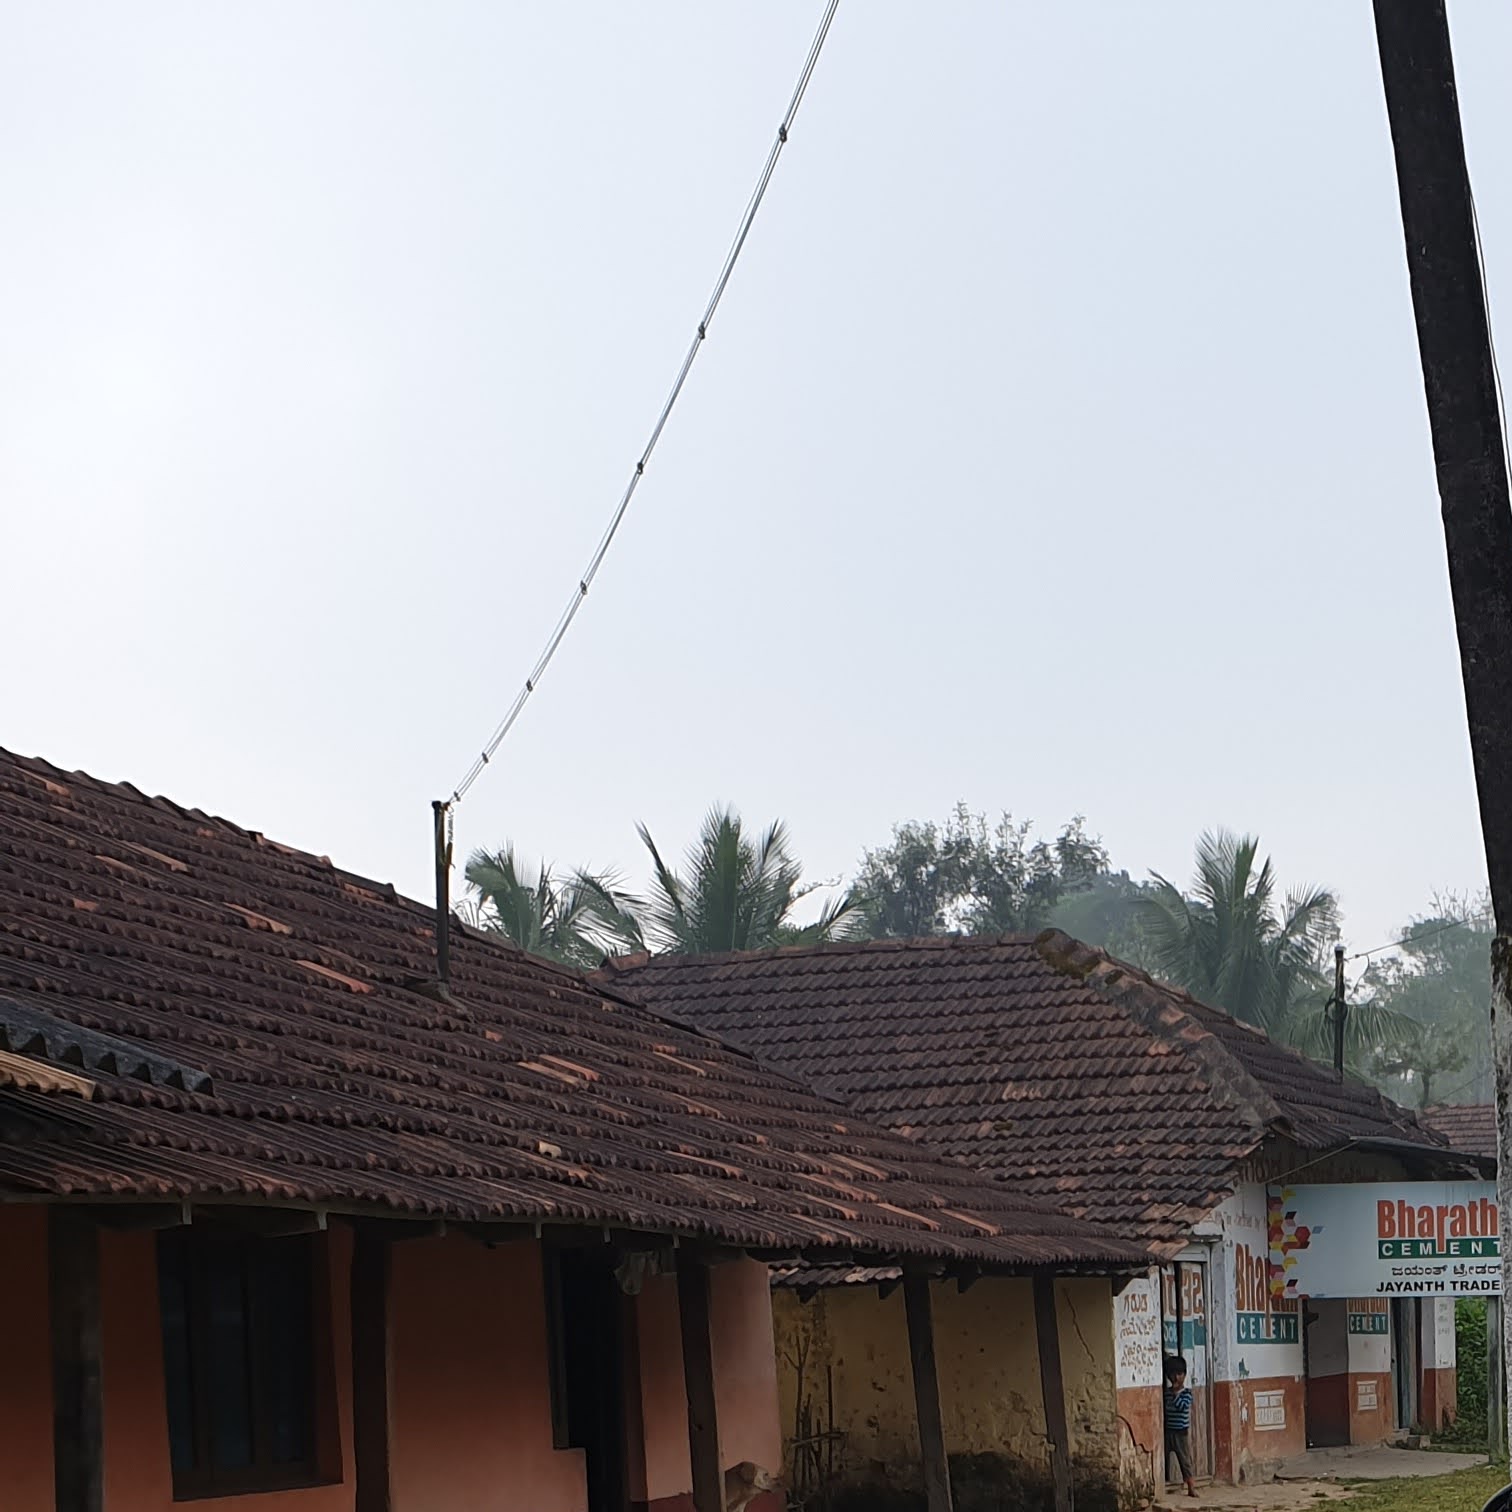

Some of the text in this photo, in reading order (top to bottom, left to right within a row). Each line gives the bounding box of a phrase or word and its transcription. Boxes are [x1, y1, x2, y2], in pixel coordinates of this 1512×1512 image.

[1377, 1197, 1499, 1254] Bharath
[1381, 1241, 1501, 1256] CEMENT
[1376, 1280, 1502, 1293] JAYANTH TRADE
[1239, 1317, 1296, 1340] CEMENT
